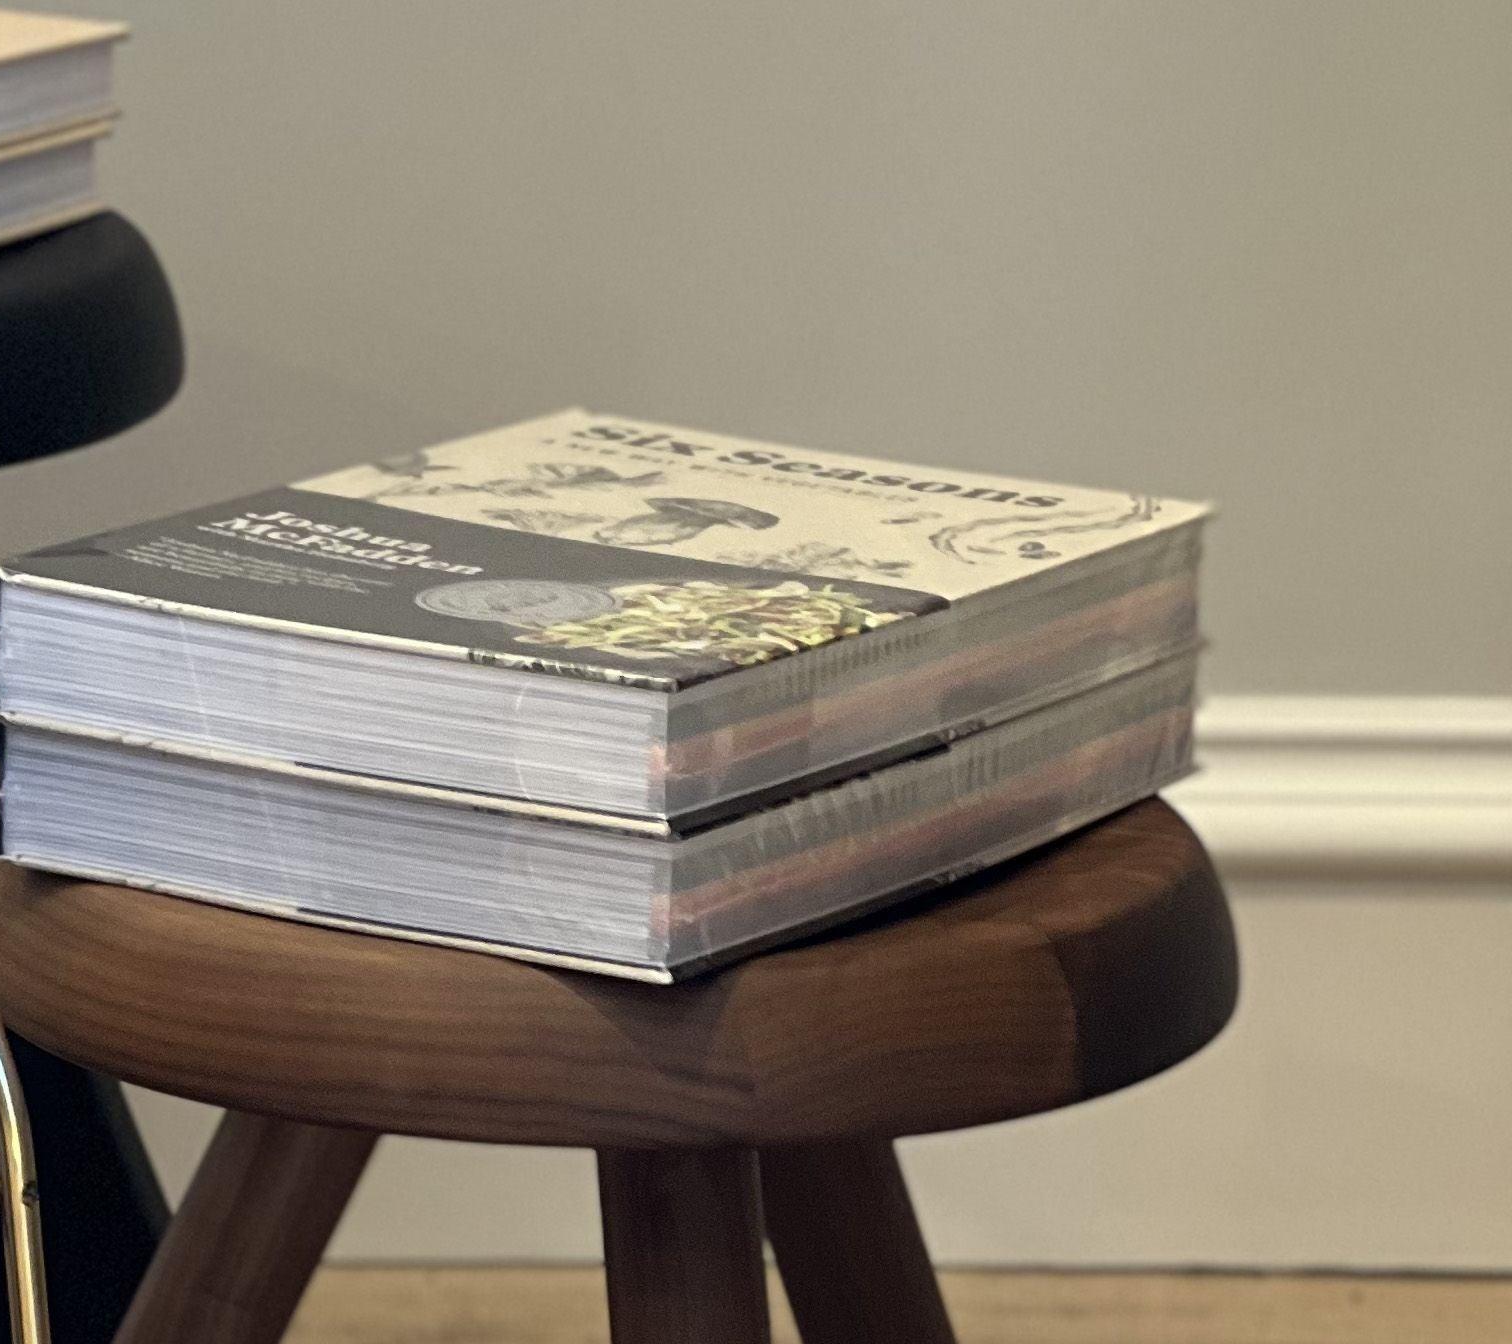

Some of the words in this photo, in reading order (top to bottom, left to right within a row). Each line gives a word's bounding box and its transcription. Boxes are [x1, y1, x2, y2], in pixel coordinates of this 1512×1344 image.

[571, 423, 716, 457] Six
[715, 449, 1066, 509] Seasons
[210, 516, 485, 576] McFadden
[245, 510, 433, 554] Joshua
